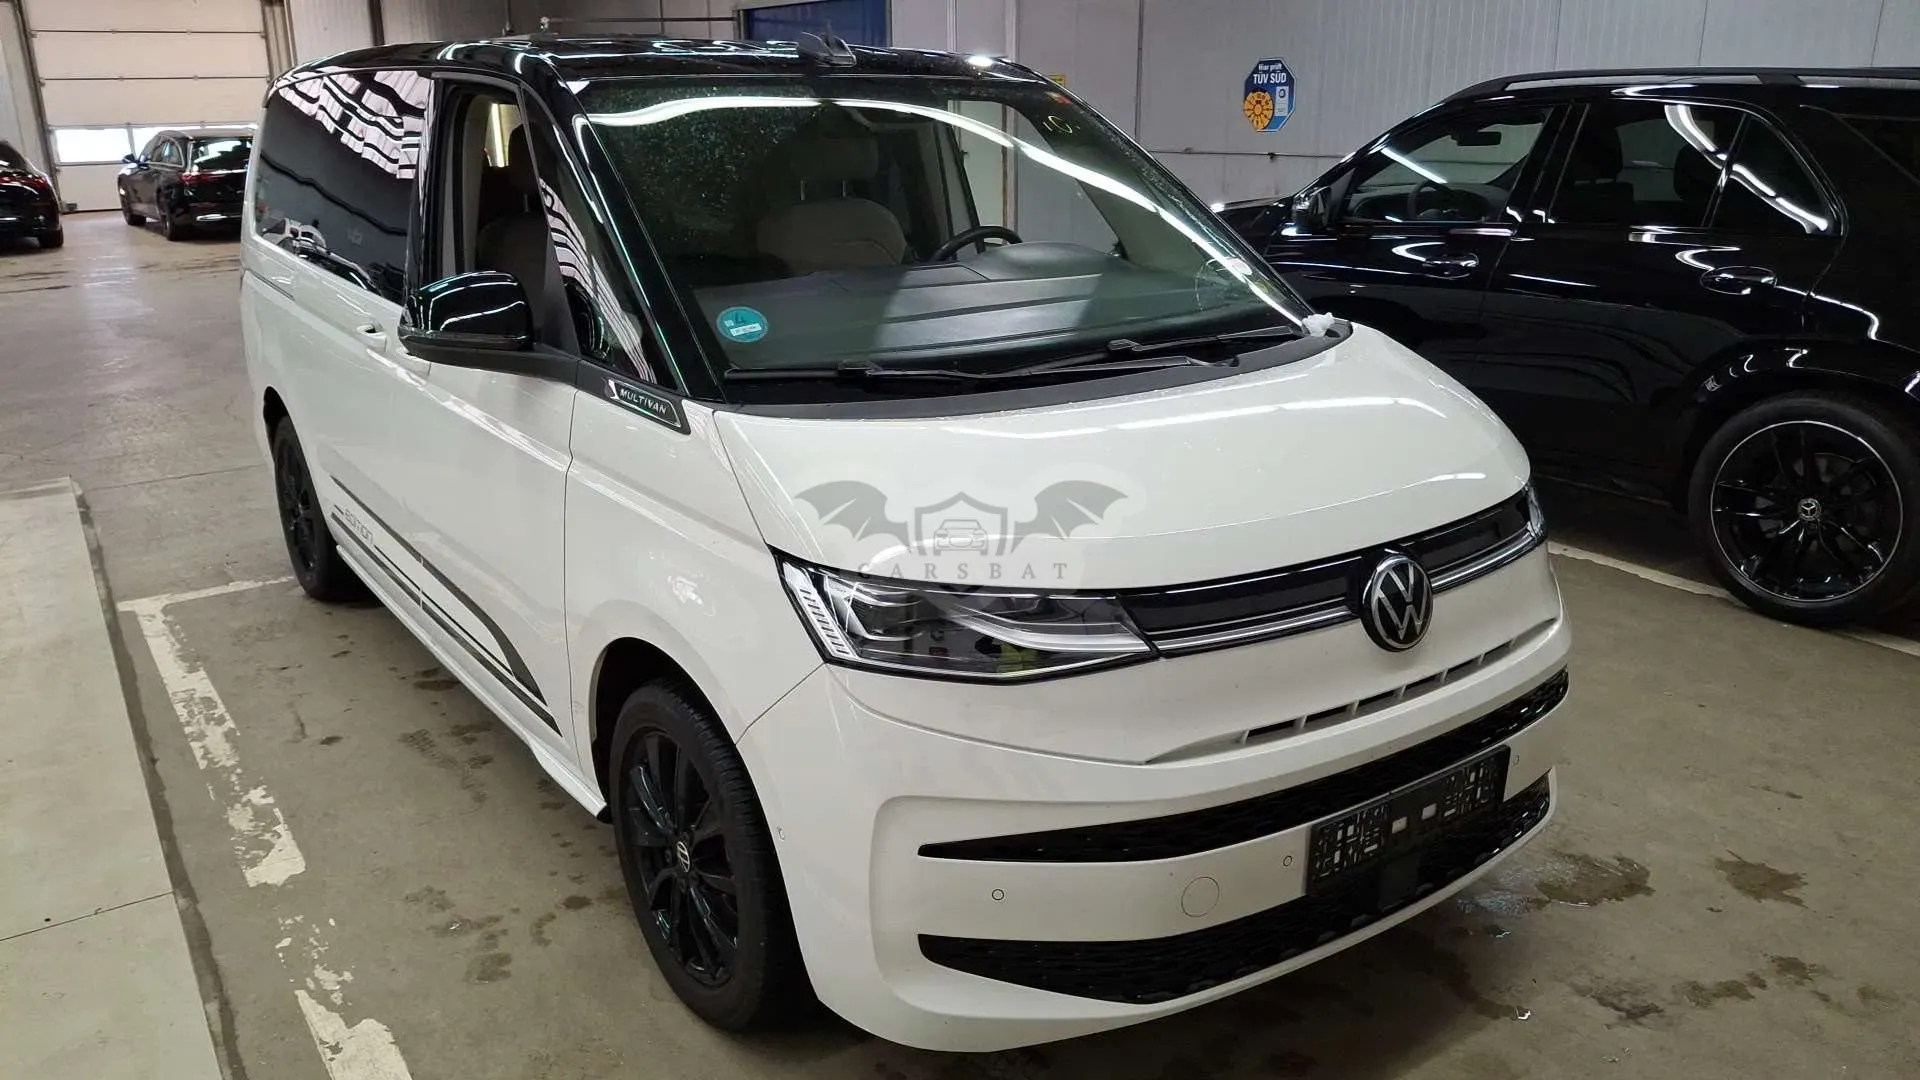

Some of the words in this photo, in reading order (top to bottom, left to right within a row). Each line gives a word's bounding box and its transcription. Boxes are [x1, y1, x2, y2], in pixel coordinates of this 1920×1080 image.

[1253, 71, 1269, 84] TÜV
[1270, 70, 1287, 84] SÜD
[620, 388, 667, 415] MULTIVAN
